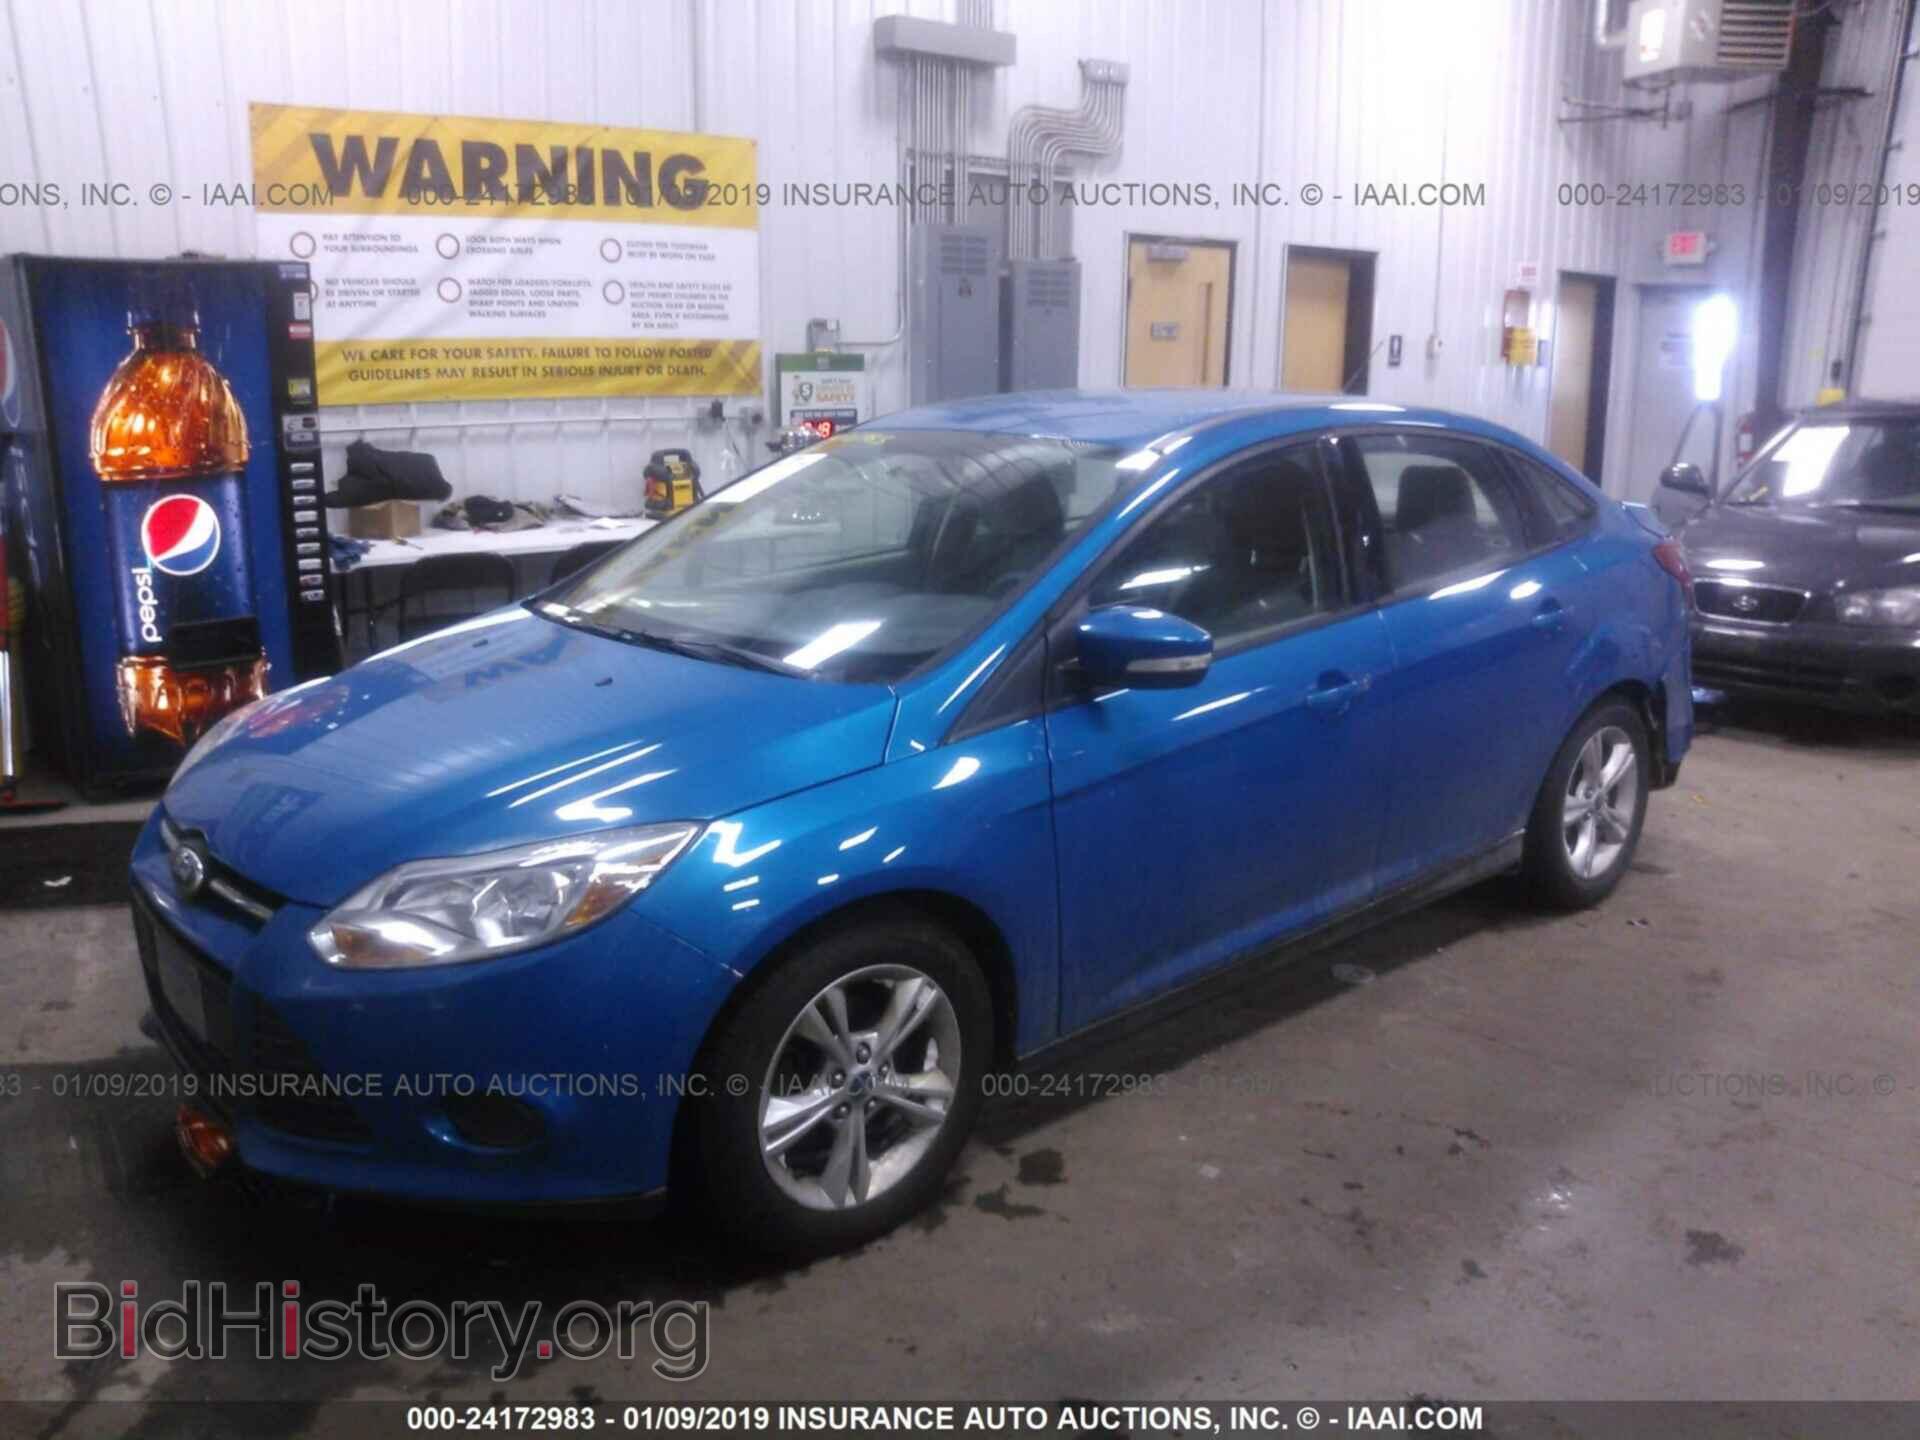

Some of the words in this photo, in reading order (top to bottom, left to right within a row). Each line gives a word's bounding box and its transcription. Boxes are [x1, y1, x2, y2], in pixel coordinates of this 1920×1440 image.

[308, 132, 709, 211] WARNING
[342, 350, 367, 362] WE
[370, 349, 406, 361] CARE
[410, 348, 439, 360] FOR
[444, 348, 482, 360] YOUR
[541, 347, 590, 359] FAILURE
[595, 347, 610, 359] TO
[615, 347, 664, 359] FOLLOW
[348, 367, 431, 381] GUIDELINES
[435, 367, 466, 378] MAY
[472, 366, 518, 378] RESULT
[522, 366, 538, 378] IN
[542, 365, 595, 378] SERIOUS
[645, 366, 664, 377] OR
[132, 567, 163, 643] pepsi
